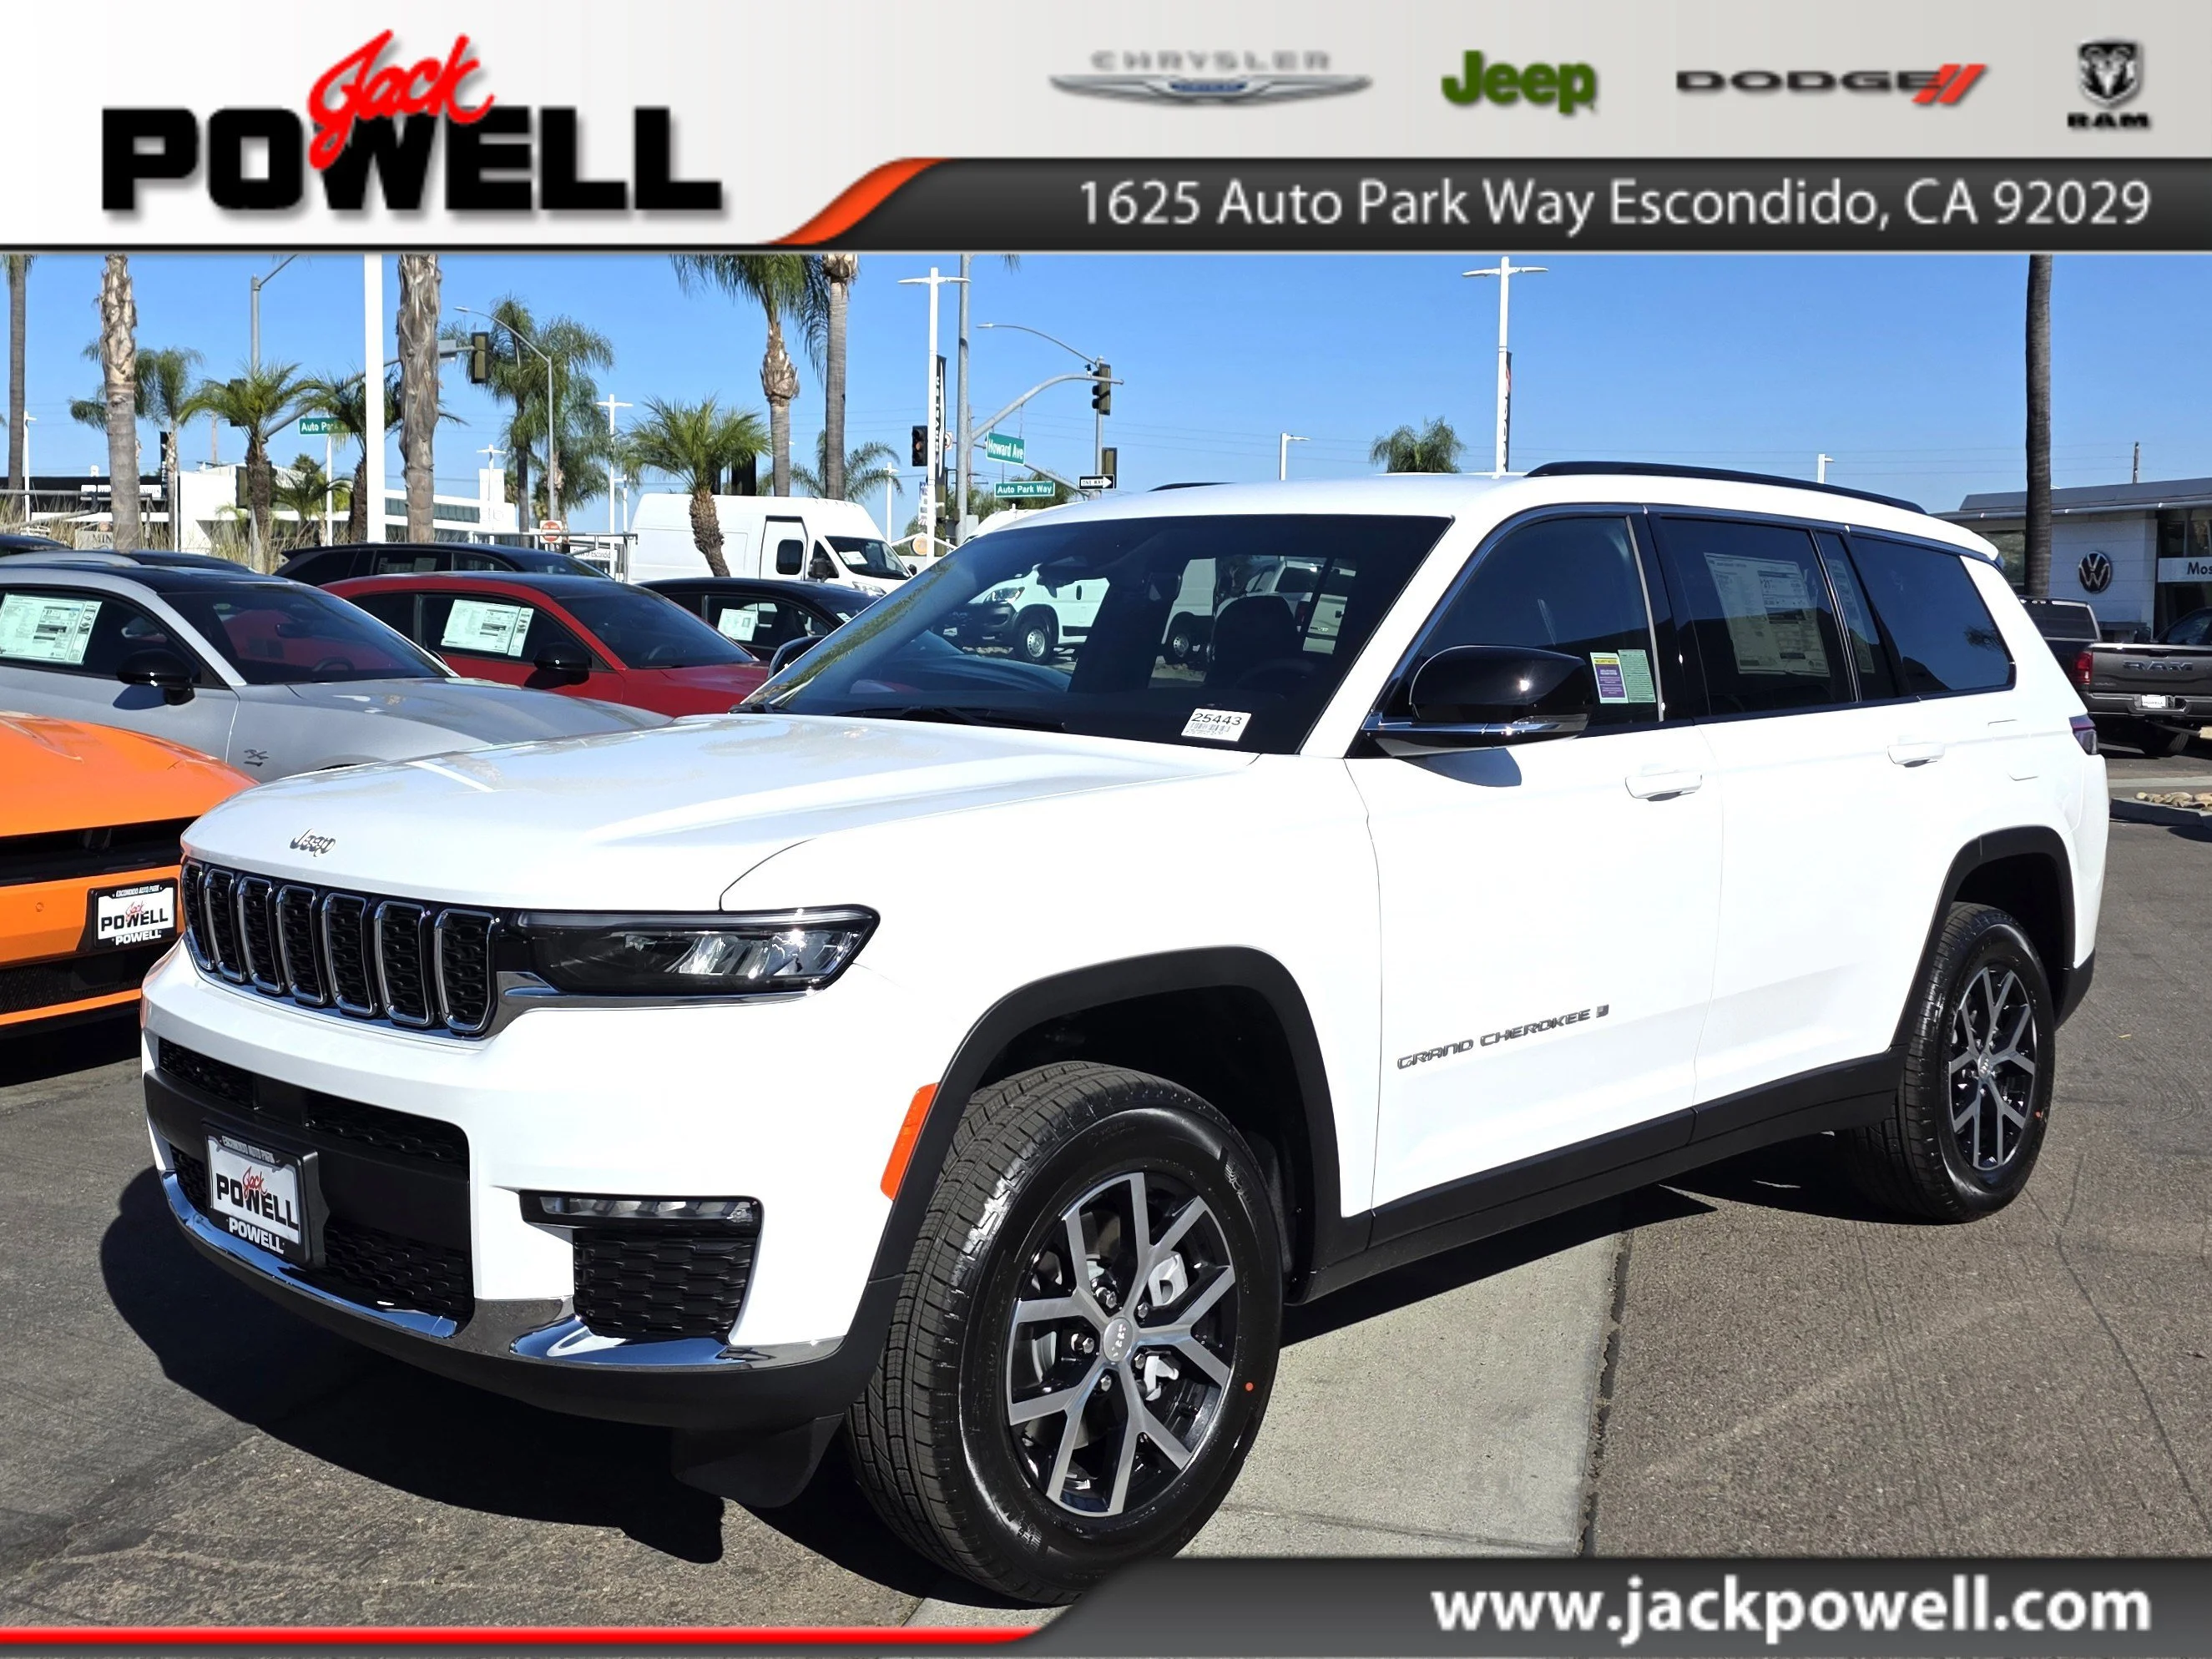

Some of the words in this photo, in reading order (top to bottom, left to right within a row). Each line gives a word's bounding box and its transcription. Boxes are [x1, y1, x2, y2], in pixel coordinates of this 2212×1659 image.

[301, 422, 319, 431] Auto
[988, 439, 1012, 458] Howard
[1013, 444, 1024, 459] Ave
[997, 486, 1015, 494] Auto
[1018, 485, 1034, 494] Park
[1036, 485, 1052, 494] Way
[2123, 660, 2193, 671] RAM
[1191, 713, 1242, 725] 25443
[290, 828, 336, 857] Jeep
[101, 908, 169, 931] POWELL
[116, 929, 161, 945] POWELL
[1397, 1039, 1474, 1070] GRAND
[1480, 1009, 1591, 1047] CHEROKEE
[242, 1166, 268, 1200] Jack
[215, 1172, 299, 1231] POWELL
[229, 1217, 285, 1254] POWELL
